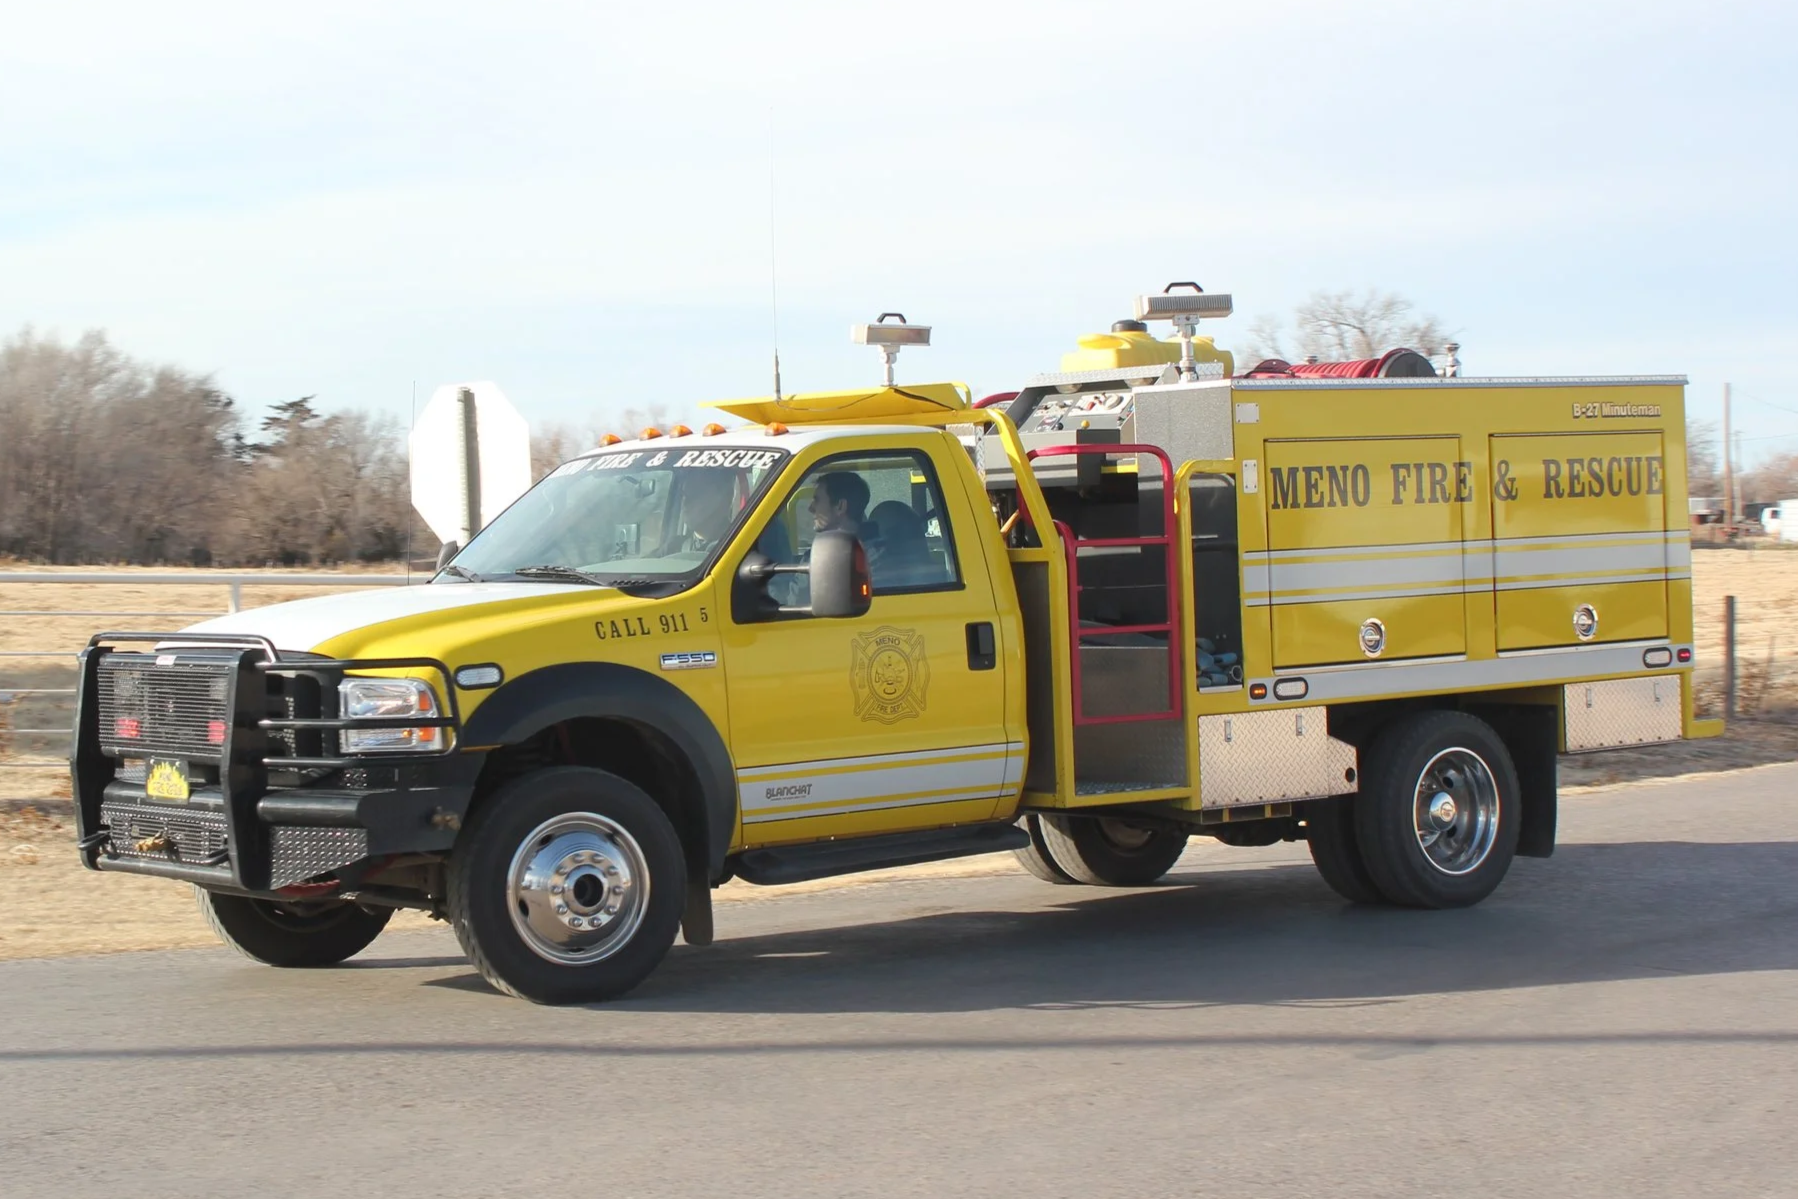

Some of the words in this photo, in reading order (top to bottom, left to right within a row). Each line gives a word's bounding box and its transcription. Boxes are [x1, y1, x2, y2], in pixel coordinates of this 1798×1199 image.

[1572, 402, 1600, 419] B-27
[1601, 402, 1662, 418] Minuteman
[586, 452, 644, 471] FIRE
[646, 450, 668, 467] &
[673, 449, 781, 469] RESCUE
[1270, 464, 1371, 509] MENO
[1390, 462, 1473, 505] FIRE
[1494, 459, 1518, 501] &
[1542, 456, 1663, 499] RESCUE
[700, 607, 708, 622] 5
[594, 617, 651, 640] CALL
[659, 612, 689, 634] 911
[875, 637, 901, 647] MENO
[765, 783, 813, 800] BLANCHAT
